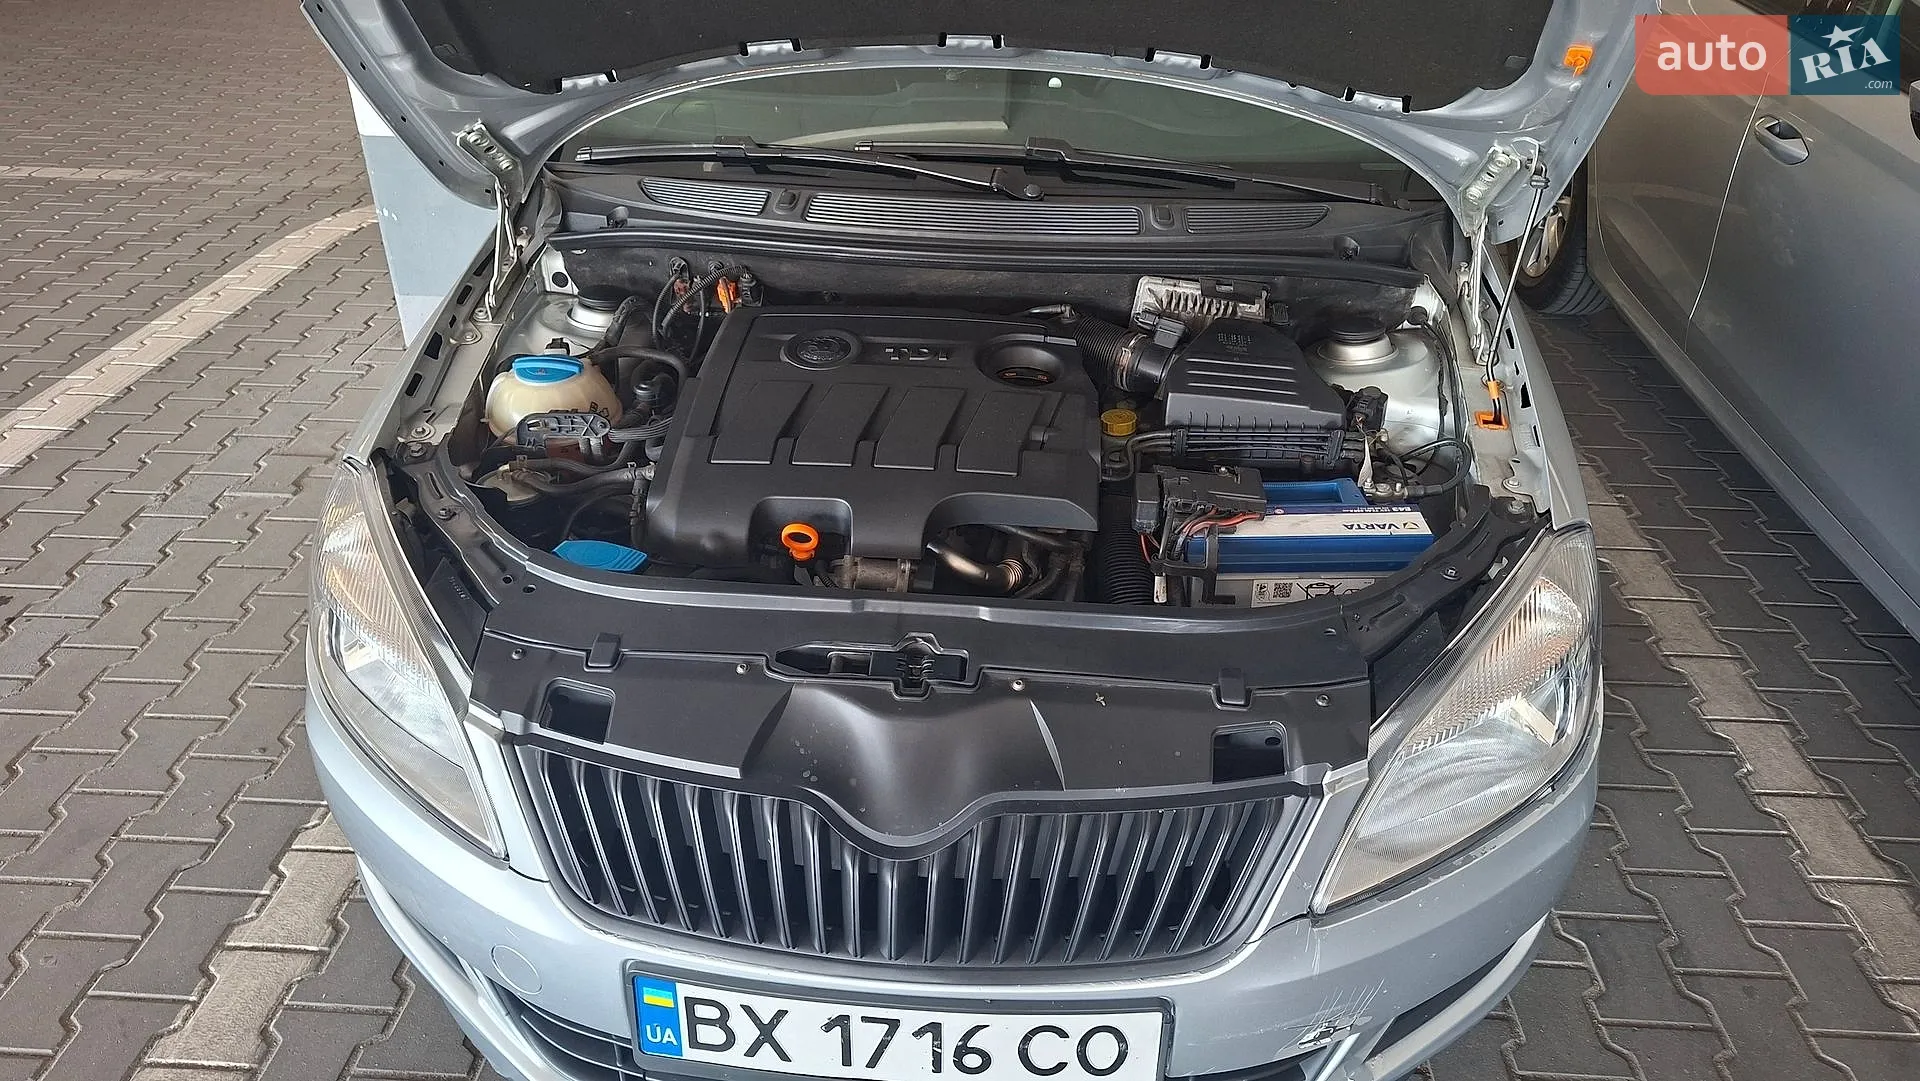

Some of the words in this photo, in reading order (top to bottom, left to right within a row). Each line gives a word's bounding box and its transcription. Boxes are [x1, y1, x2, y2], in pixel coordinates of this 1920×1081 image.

[646, 1023, 677, 1046] UA
[685, 996, 793, 1063] BX
[820, 1014, 993, 1076] 1716
[1017, 1025, 1129, 1077] CO
